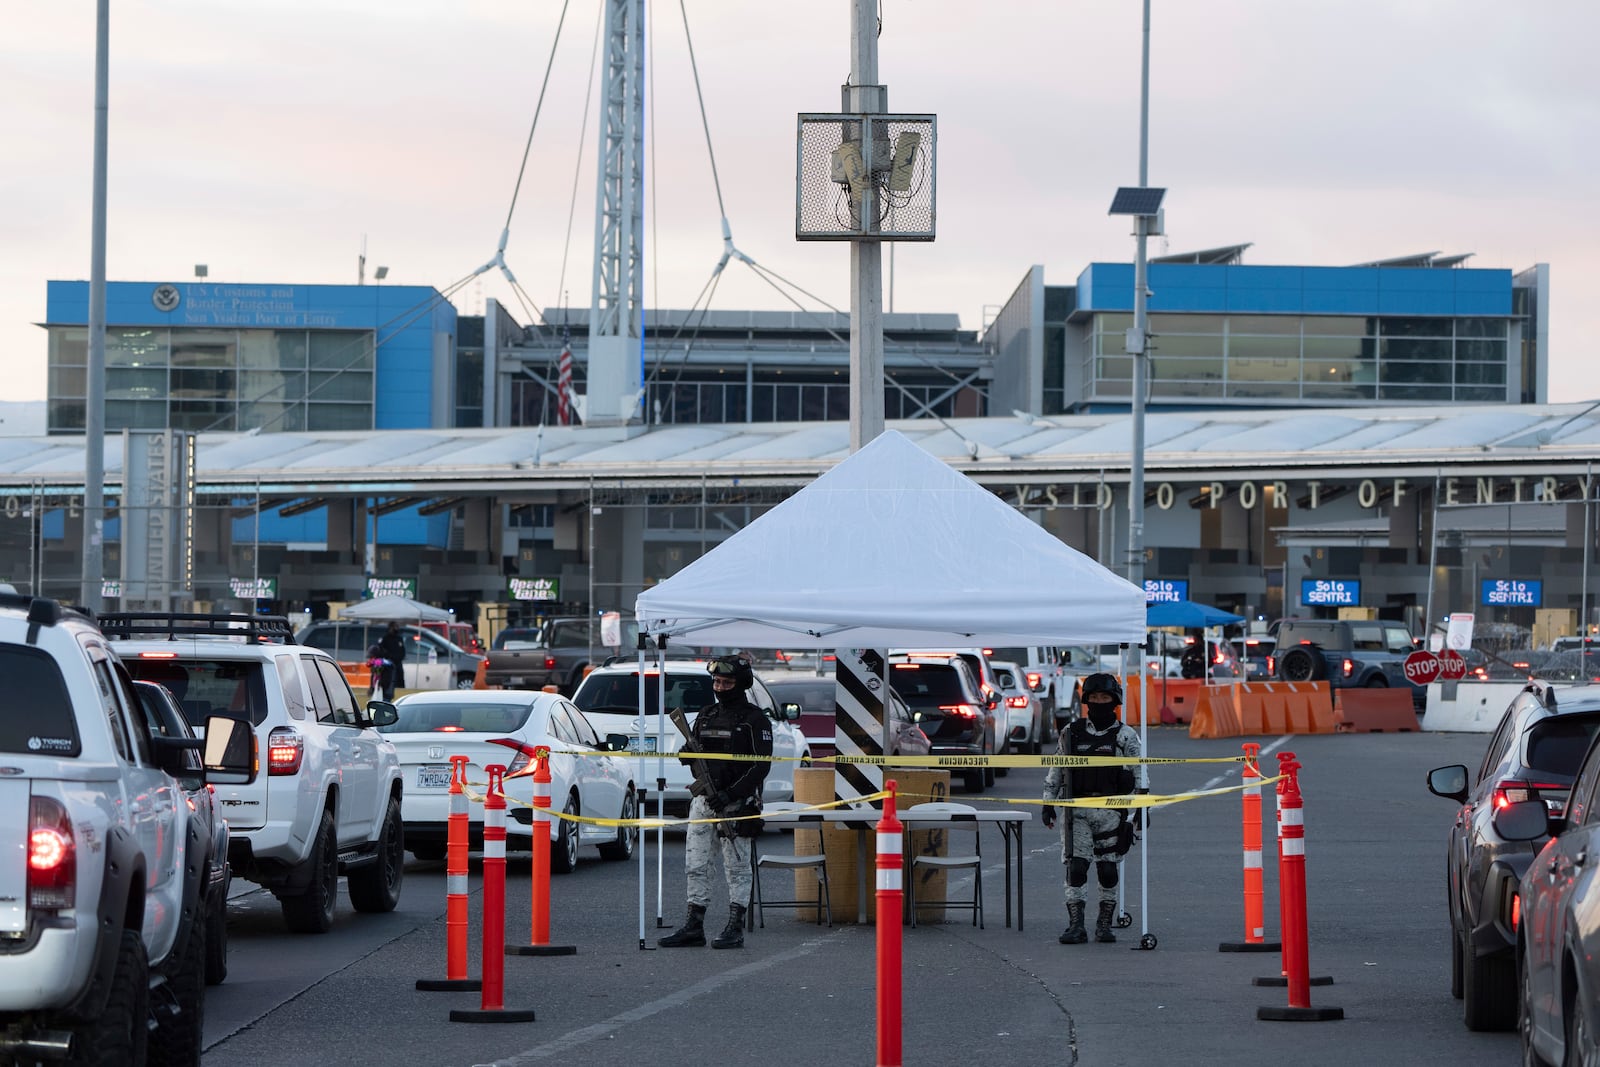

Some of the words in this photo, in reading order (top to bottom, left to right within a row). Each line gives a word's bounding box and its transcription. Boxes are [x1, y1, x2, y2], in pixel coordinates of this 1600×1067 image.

[213, 286, 266, 298] Customs
[271, 288, 294, 298] and
[186, 298, 226, 310] Border
[231, 298, 294, 311] Protection
[185, 312, 207, 324] San
[255, 313, 280, 325] Port
[285, 313, 297, 325] of
[303, 314, 336, 327] Entry
[149, 434, 165, 506] STATES
[1016, 482, 1174, 511] YSIDO
[1209, 481, 1321, 510] PORT
[1358, 479, 1407, 509] OF
[1445, 476, 1594, 506] ENTRY
[148, 514, 164, 592] UNITED
[368, 578, 411, 592] Ready
[510, 578, 553, 592] Ready
[1145, 580, 1173, 592] Solo
[1315, 580, 1345, 592] Solo
[1144, 591, 1180, 602] ENTRI
[1308, 591, 1353, 603] SENTRI
[1488, 591, 1533, 603] SENTRI
[1406, 659, 1437, 677] STOP
